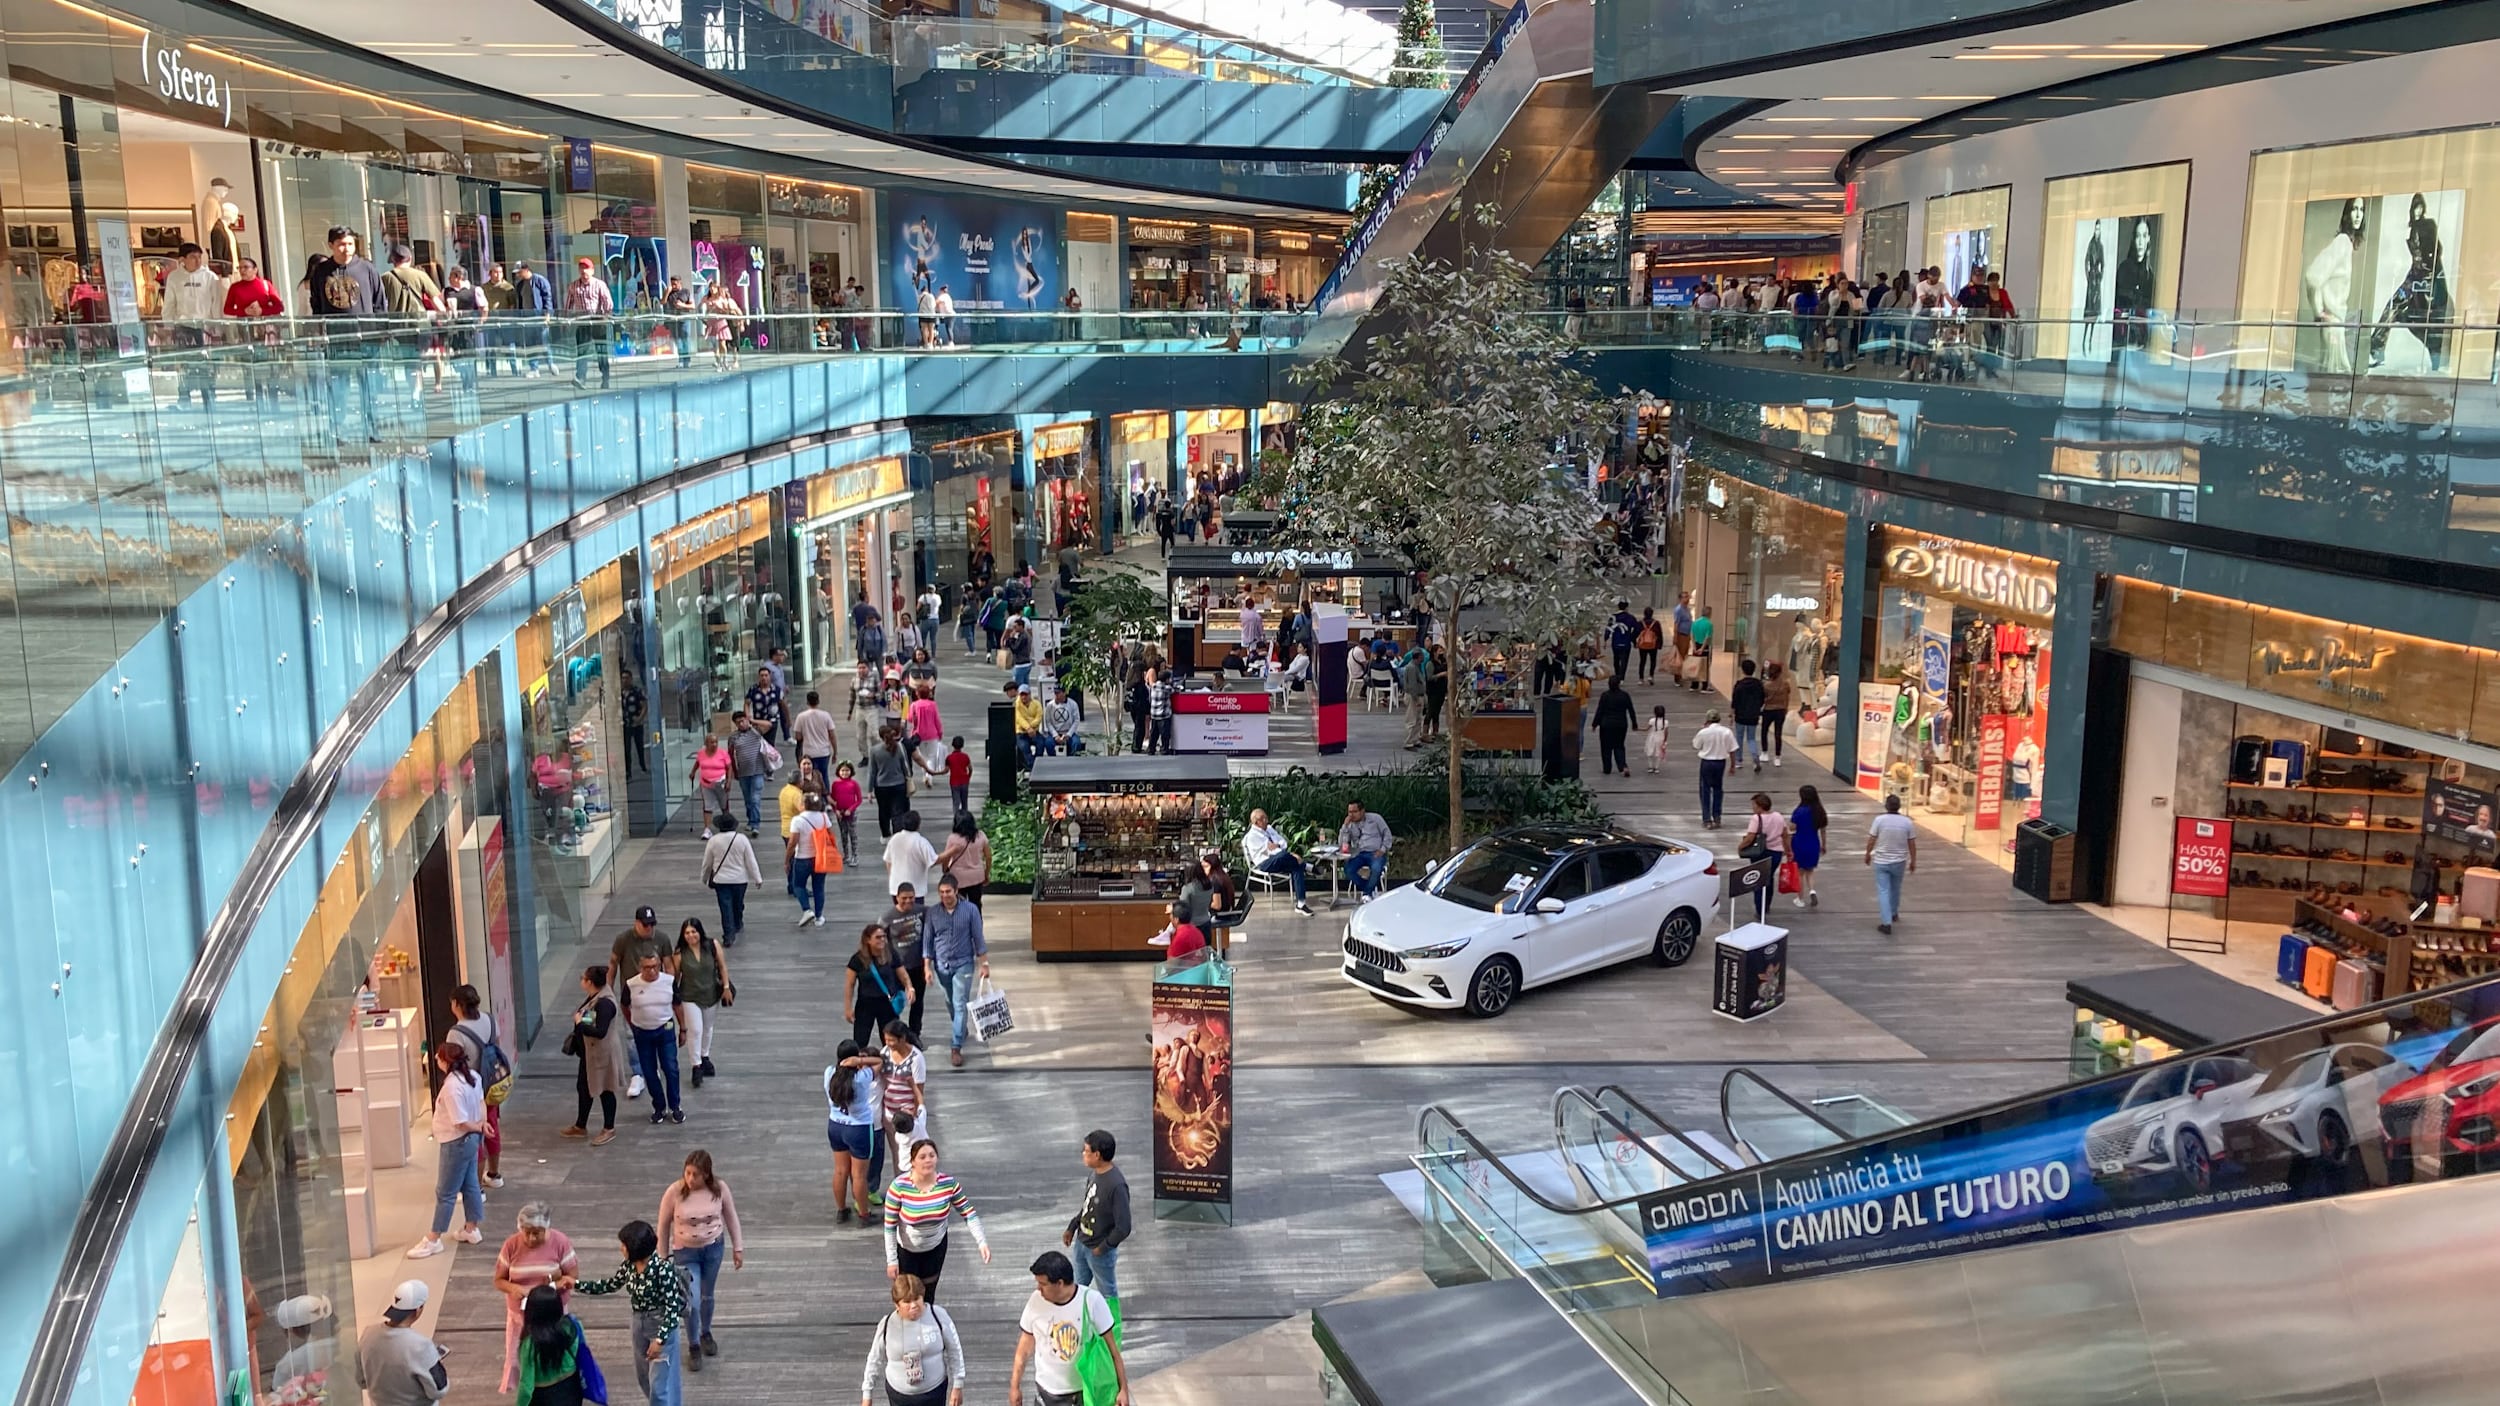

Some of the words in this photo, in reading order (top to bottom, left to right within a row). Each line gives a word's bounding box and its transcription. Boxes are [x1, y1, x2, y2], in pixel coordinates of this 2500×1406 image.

[1501, 9, 1524, 53] telcel
[1477, 58, 1495, 84] video
[1320, 281, 1336, 313] telcel
[1339, 249, 1362, 283] PLAN
[1362, 199, 1394, 251] TELCEL
[1393, 165, 1417, 203] PLUS
[1417, 151, 1425, 169] 4
[1231, 551, 1285, 565] SANTA
[1208, 695, 1237, 705] Contigo
[1217, 703, 1241, 711] rumbo
[1979, 726, 2006, 814] REBAJAS
[2180, 844, 2226, 858] HASTA
[1162, 1178, 1209, 1187] NOVIEMBRE
[1826, 1156, 1890, 1198] inicia
[1892, 1152, 1923, 1183] tu
[1651, 1188, 1749, 1230] OMODA
[1775, 1199, 1884, 1250] CAMINO
[1891, 1191, 1928, 1231] AL
[1934, 1161, 2071, 1222] FUTURO
[2061, 1216, 2085, 1228] costos
[2085, 1215, 2096, 1224] en
[2097, 1211, 2113, 1222] esta
[2115, 1205, 2145, 1219] imagen
[2146, 1199, 2179, 1214] pueden
[2179, 1193, 2214, 1208] cambiar
[2215, 1190, 2230, 1203] sin
[2231, 1186, 2261, 1202] previo
[2262, 1181, 2292, 1194] aviso.
[1713, 1244, 1721, 1254] de
